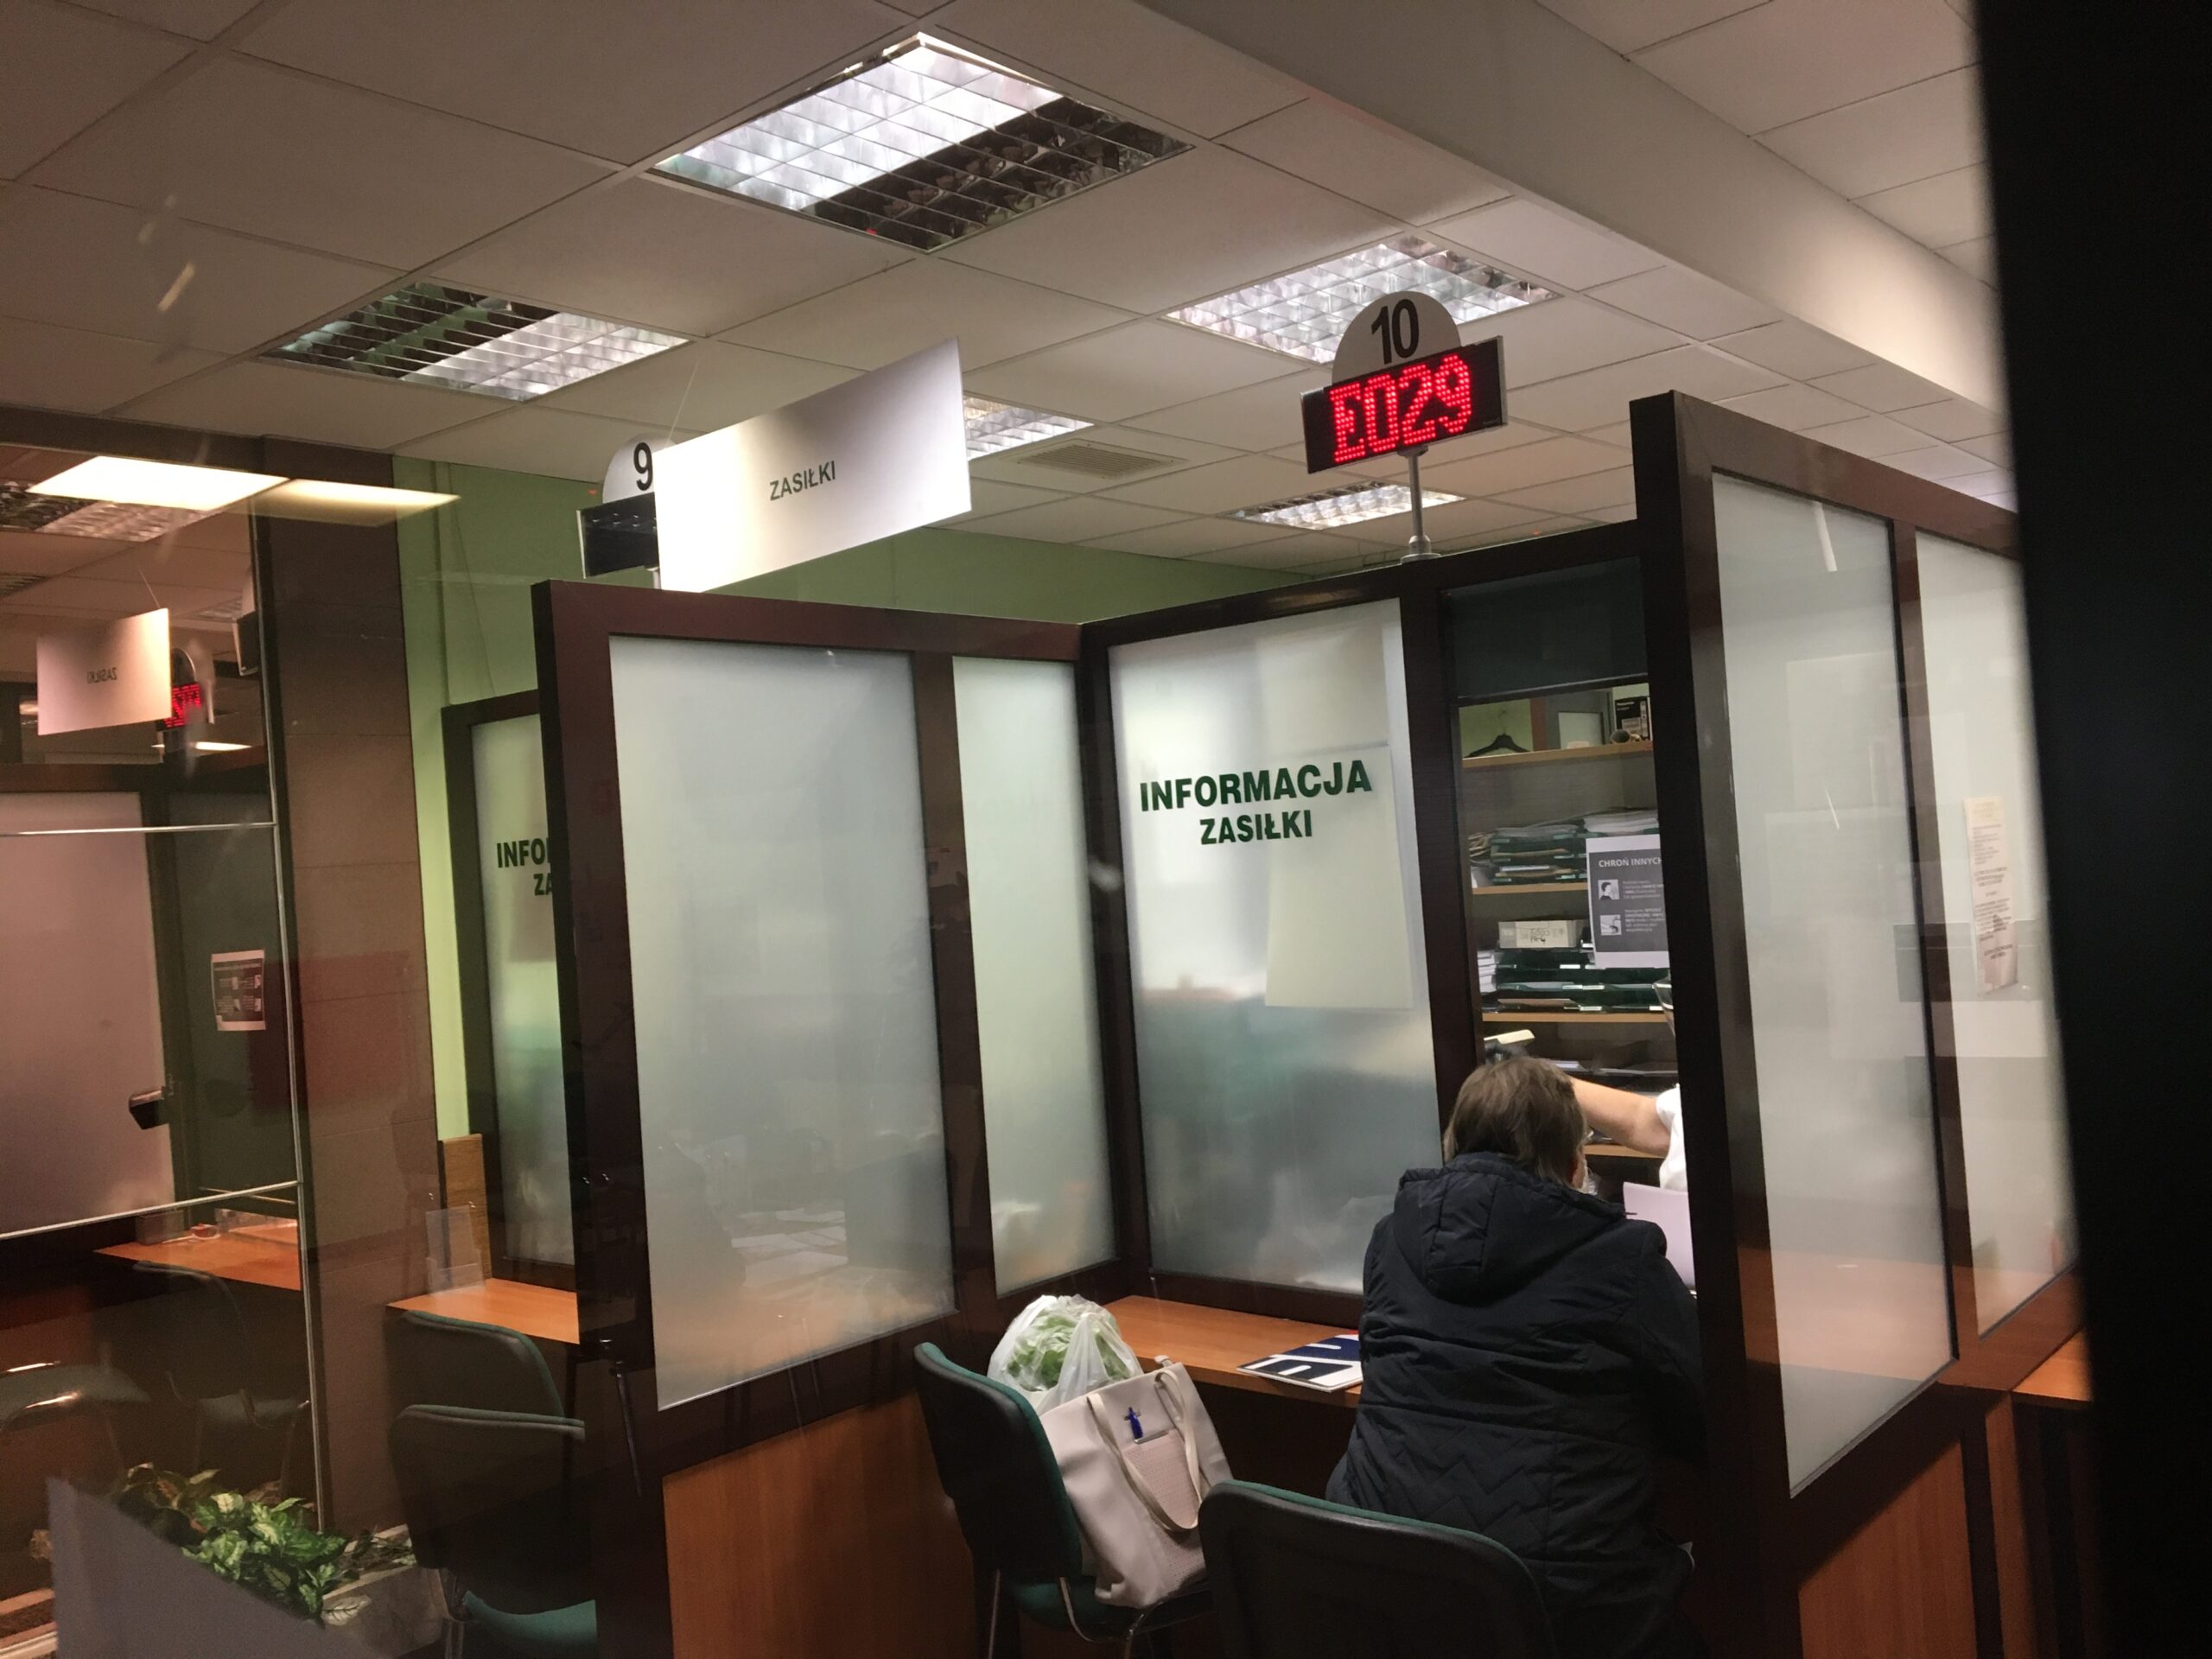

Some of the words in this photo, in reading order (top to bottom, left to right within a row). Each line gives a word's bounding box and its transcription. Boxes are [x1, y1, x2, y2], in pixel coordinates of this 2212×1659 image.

[1371, 299, 1420, 365] 10
[1329, 353, 1472, 463] E029
[633, 442, 654, 492] 9
[769, 460, 836, 501] ZASIŁKI
[1139, 760, 1373, 812] INFORMACJA
[496, 837, 551, 868] INFO
[1199, 809, 1313, 846] ZASIŁKI
